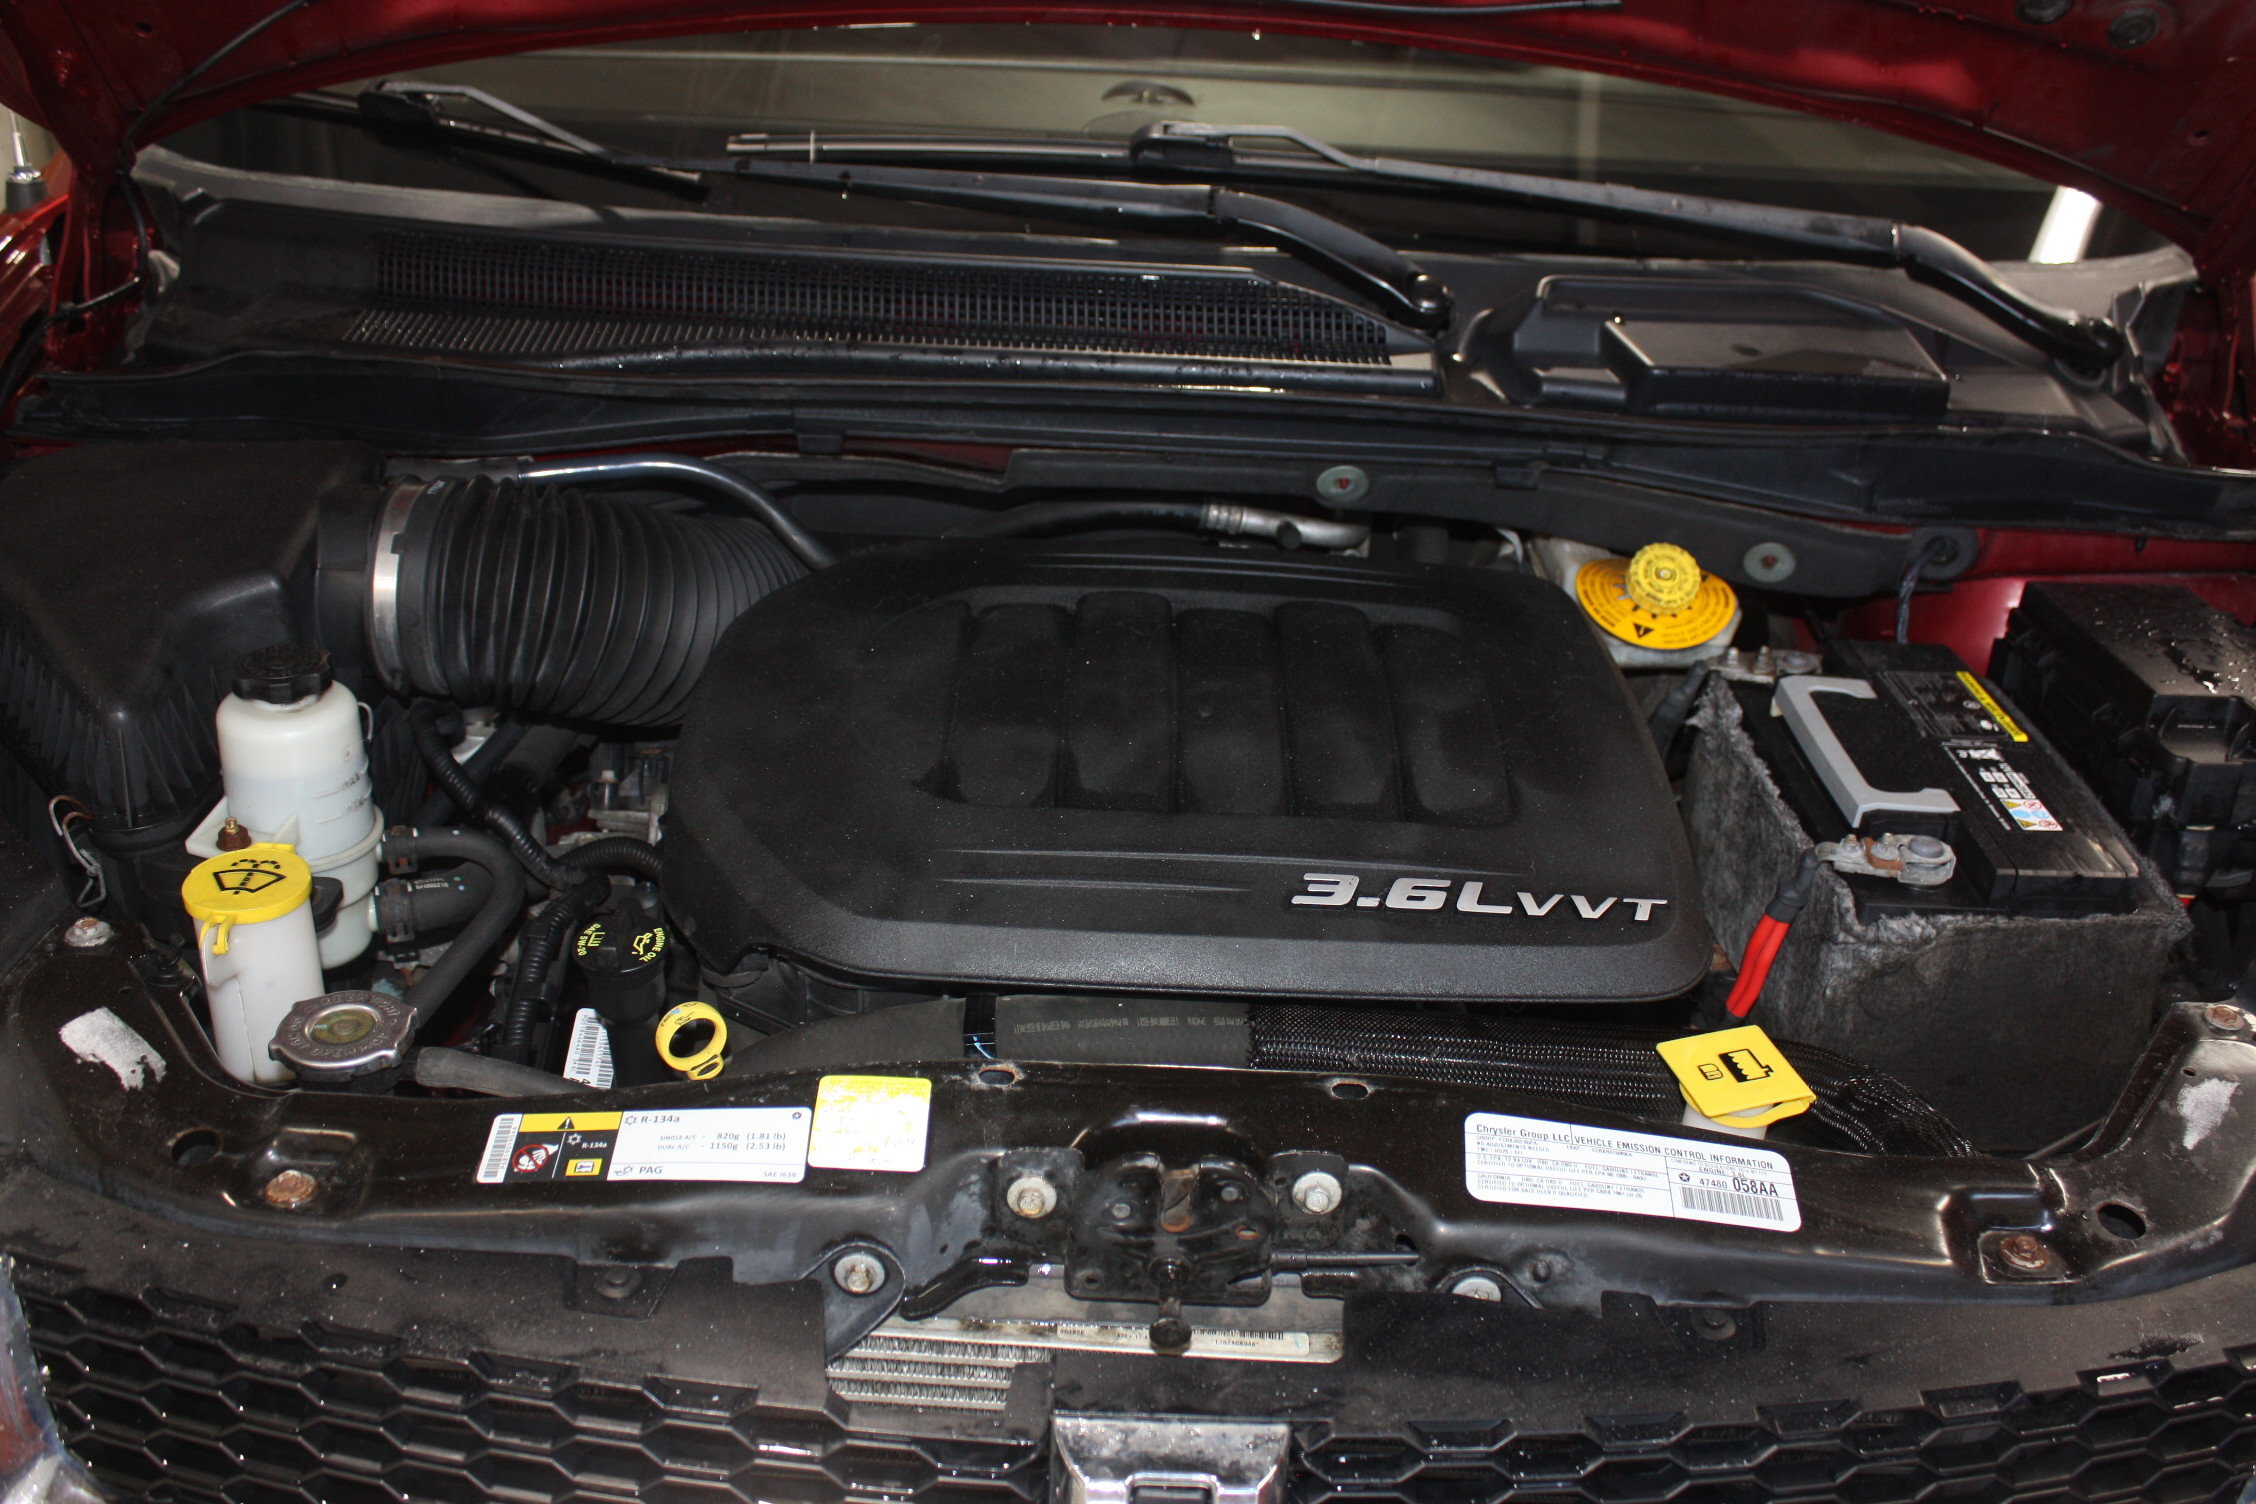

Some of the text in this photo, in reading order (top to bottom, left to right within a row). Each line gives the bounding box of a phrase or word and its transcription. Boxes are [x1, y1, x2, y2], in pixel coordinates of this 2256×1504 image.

[1291, 872, 1668, 920] 3.6L VVT
[577, 936, 588, 956] 5W-20
[639, 928, 666, 962] ENGINE OIL
[640, 1115, 680, 1123] R-134a
[717, 1132, 739, 1141] 820g
[747, 1132, 770, 1141] (1.81
[773, 1132, 786, 1141] lb)
[710, 1142, 738, 1151] 1150g
[746, 1142, 770, 1151] (2.53
[773, 1142, 786, 1151] lb)
[1476, 1124, 1773, 1170] Chrysler Group LLC VEHICLE EMISSION CONTROL INFORMATION
[639, 1166, 663, 1174] PAG
[1699, 1166, 1729, 1176] ENGINE:
[1699, 1178, 1778, 1197] 47480 058AA
